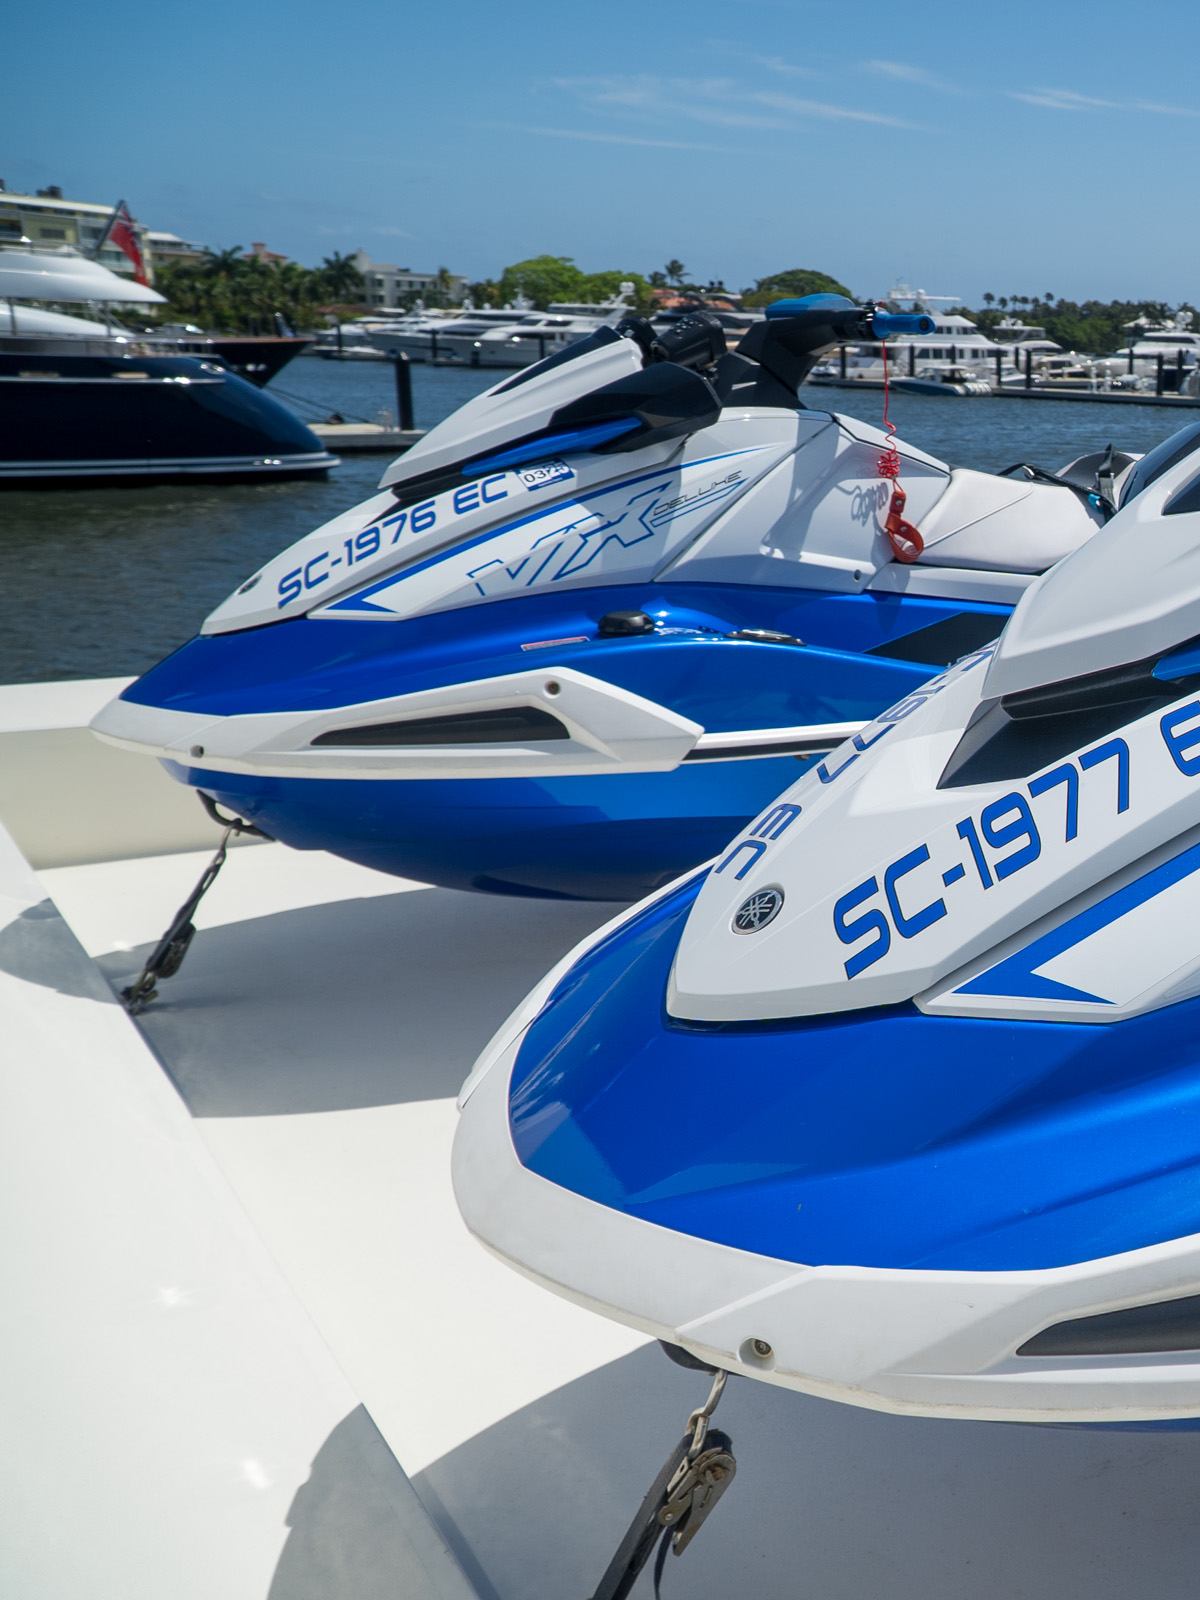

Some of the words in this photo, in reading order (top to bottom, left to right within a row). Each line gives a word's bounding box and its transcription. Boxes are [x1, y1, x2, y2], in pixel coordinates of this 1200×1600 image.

[523, 470, 547, 482] 03
[653, 470, 743, 516] DELUXE
[278, 500, 436, 610] SC-1976
[453, 473, 508, 515] EC
[833, 737, 1130, 980] SC-1977
